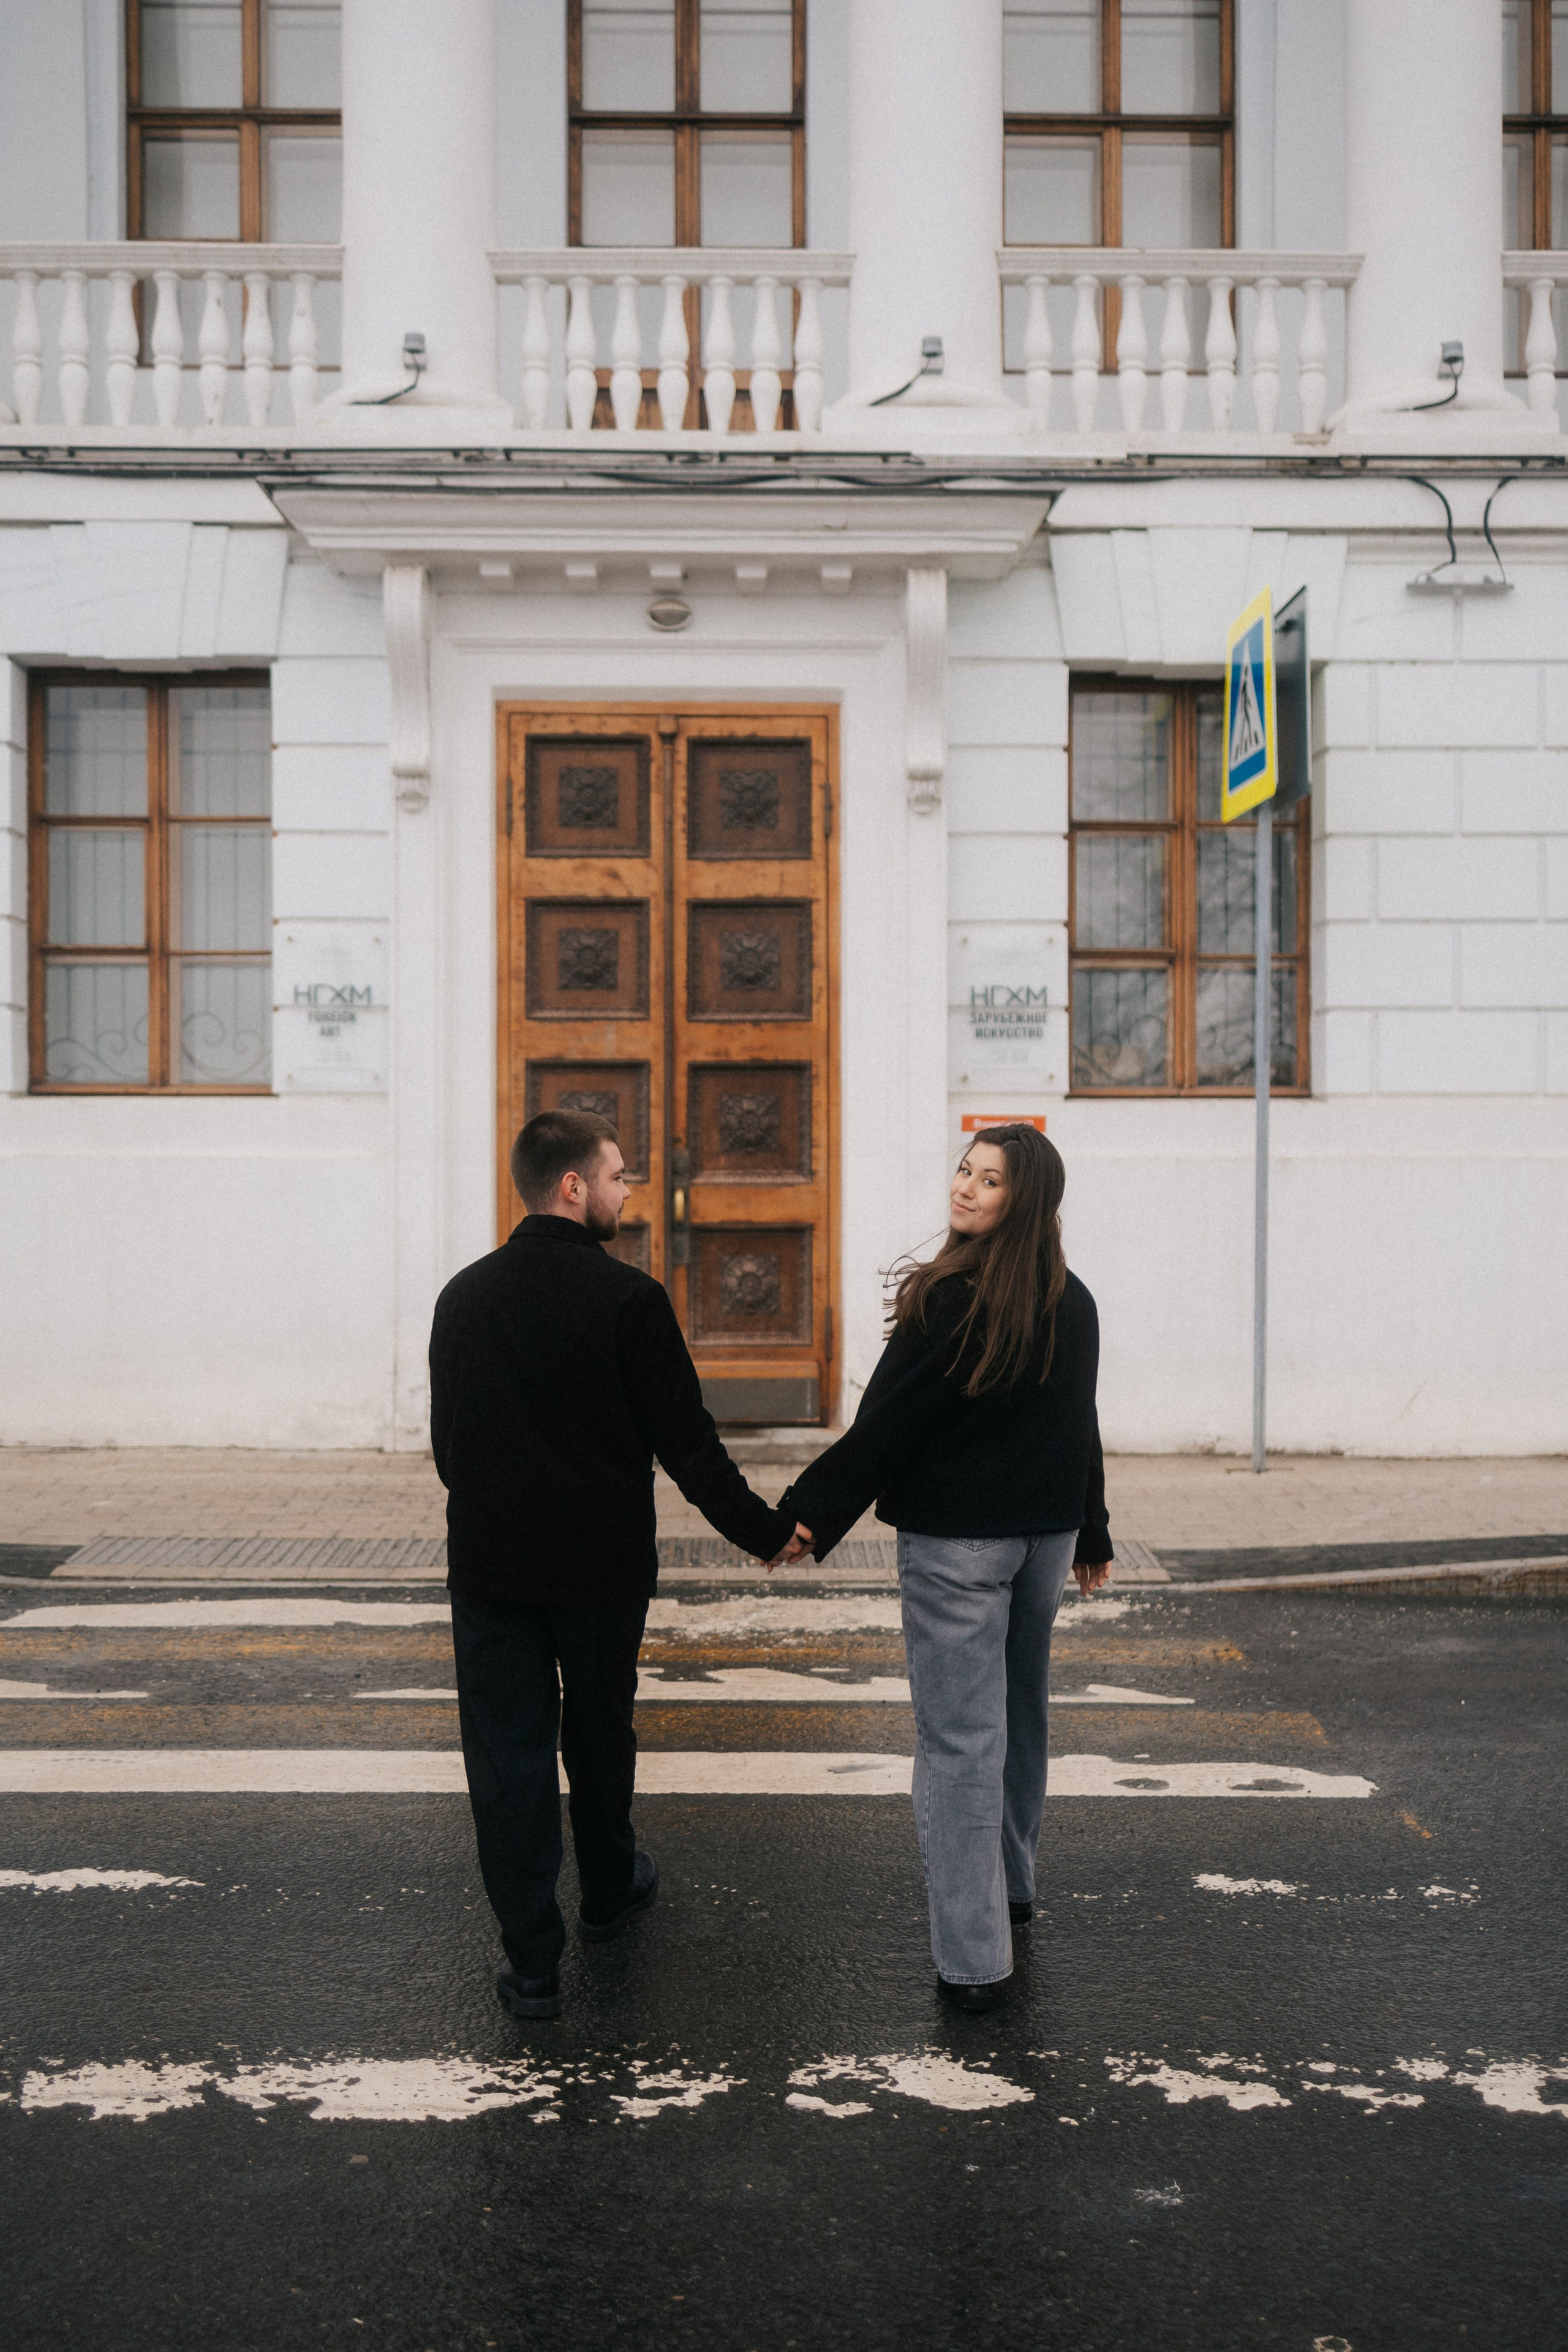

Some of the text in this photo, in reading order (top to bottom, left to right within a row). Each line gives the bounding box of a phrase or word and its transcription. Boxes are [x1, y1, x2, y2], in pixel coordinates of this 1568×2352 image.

[294, 984, 372, 1003] НГХМ
[971, 984, 1048, 1006] НГХМ
[971, 1012, 1048, 1023] ЗАРУБЕЖНОЕ
[976, 1027, 1044, 1039] ИСКУССТВО
